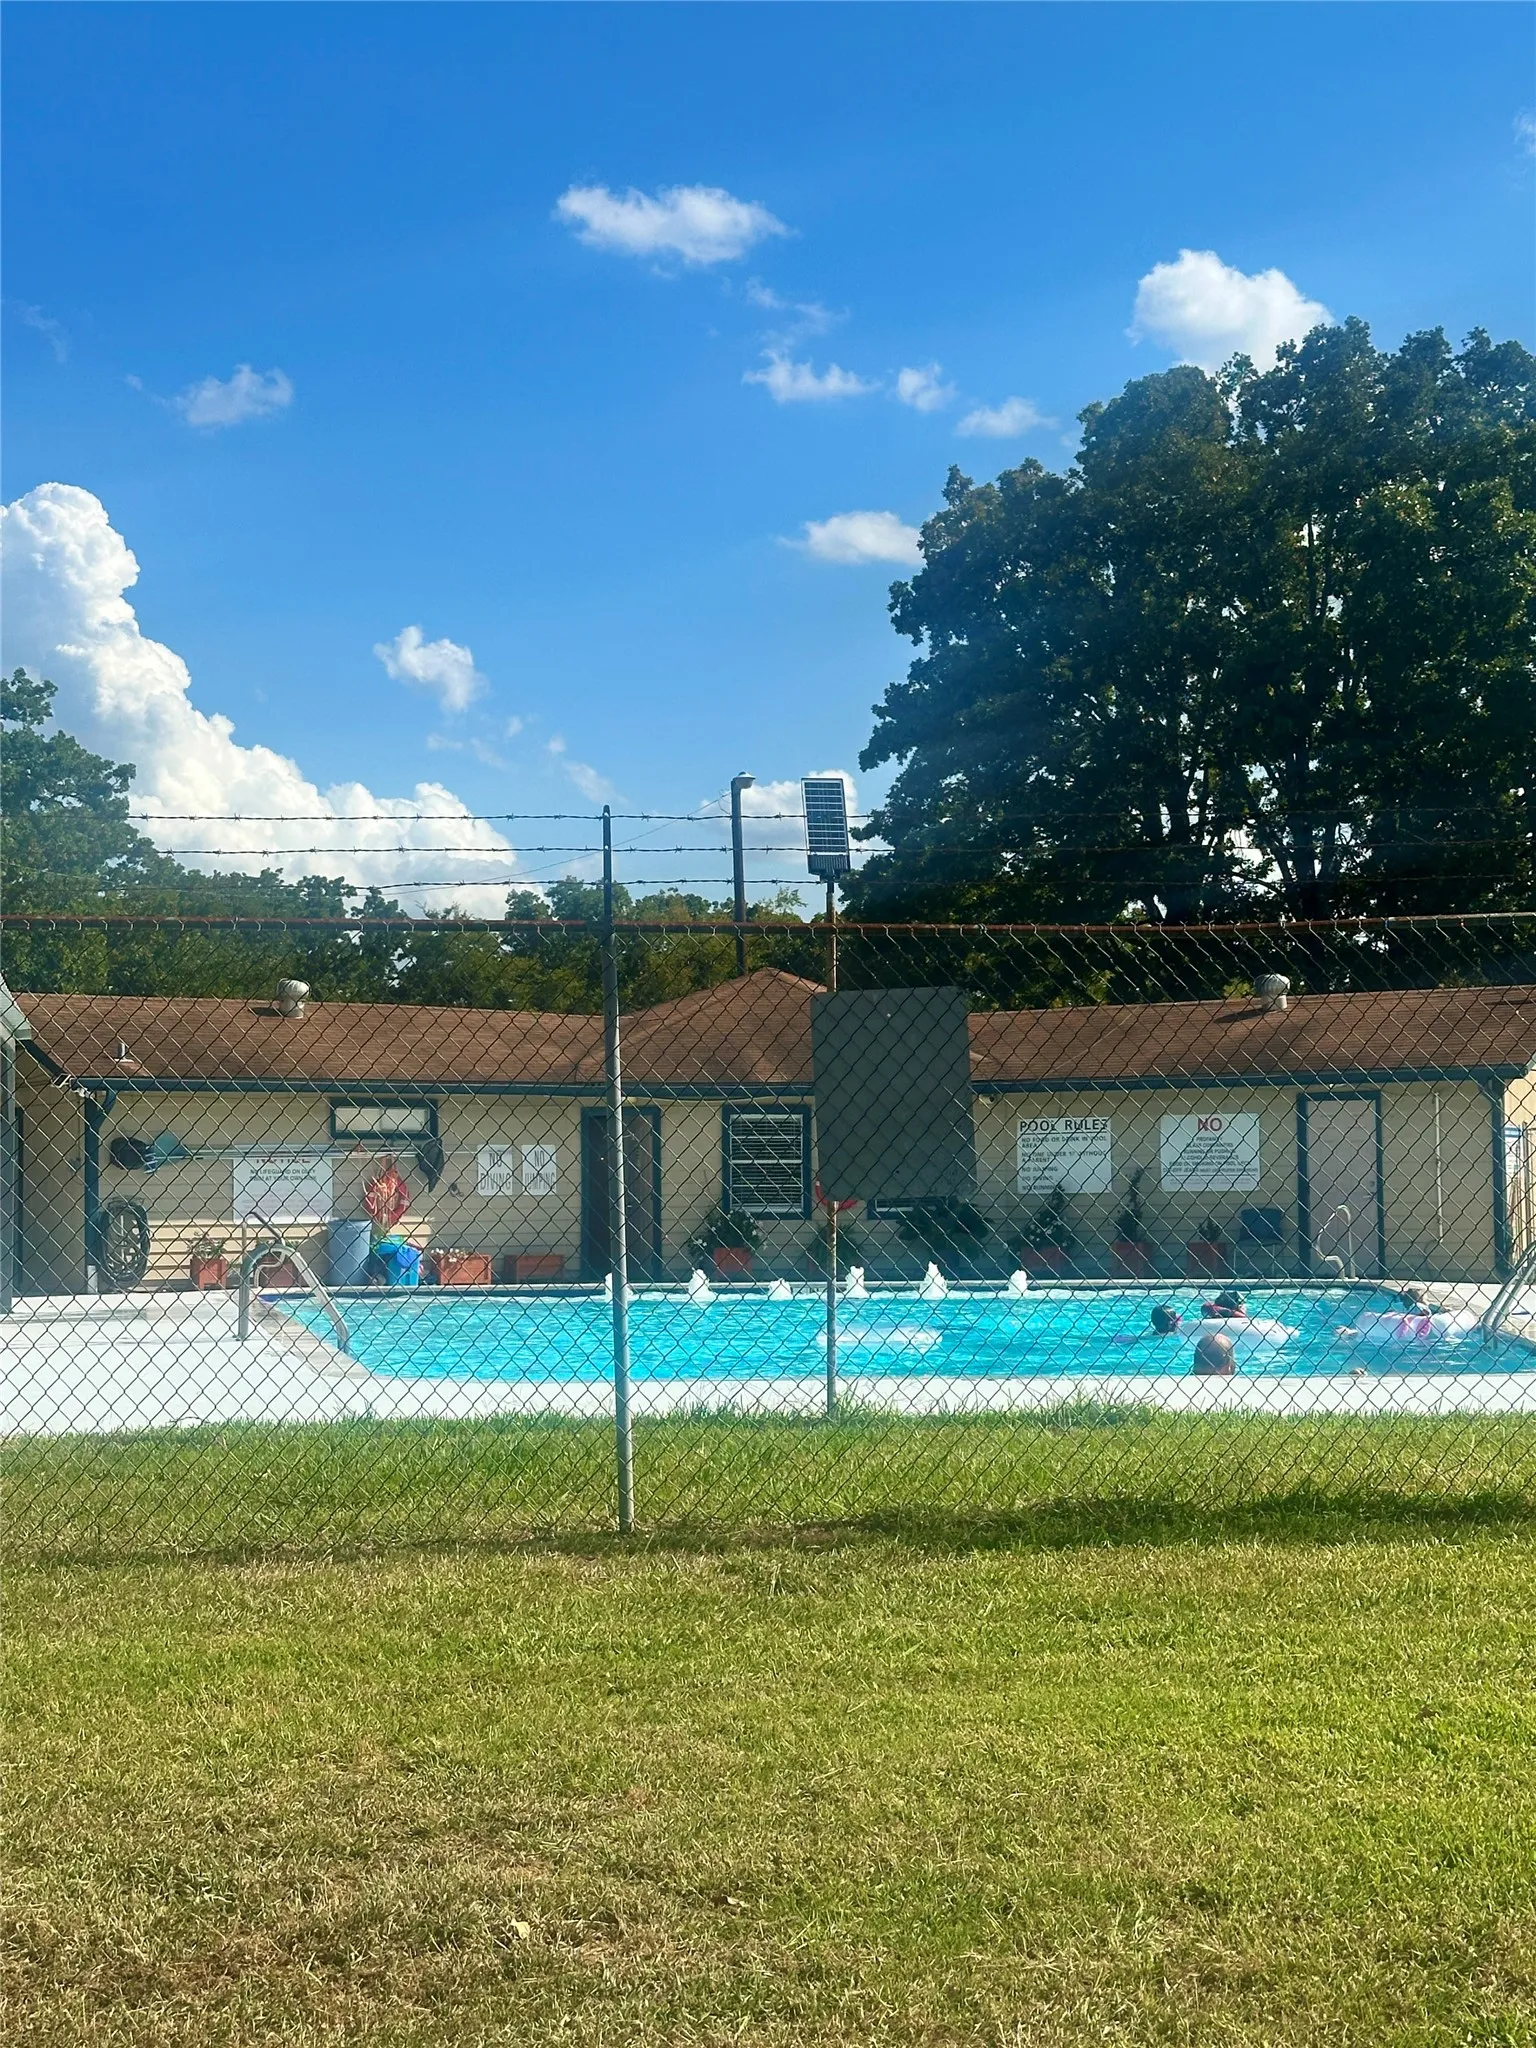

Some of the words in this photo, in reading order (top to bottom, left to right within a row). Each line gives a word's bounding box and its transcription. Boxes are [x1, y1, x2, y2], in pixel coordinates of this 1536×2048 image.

[1020, 1120, 1057, 1131] POOL
[1064, 1119, 1107, 1131] RULES
[1197, 1117, 1222, 1131] NO
[489, 1150, 502, 1167] NO
[534, 1150, 545, 1167] NO
[480, 1172, 511, 1190] DIVING
